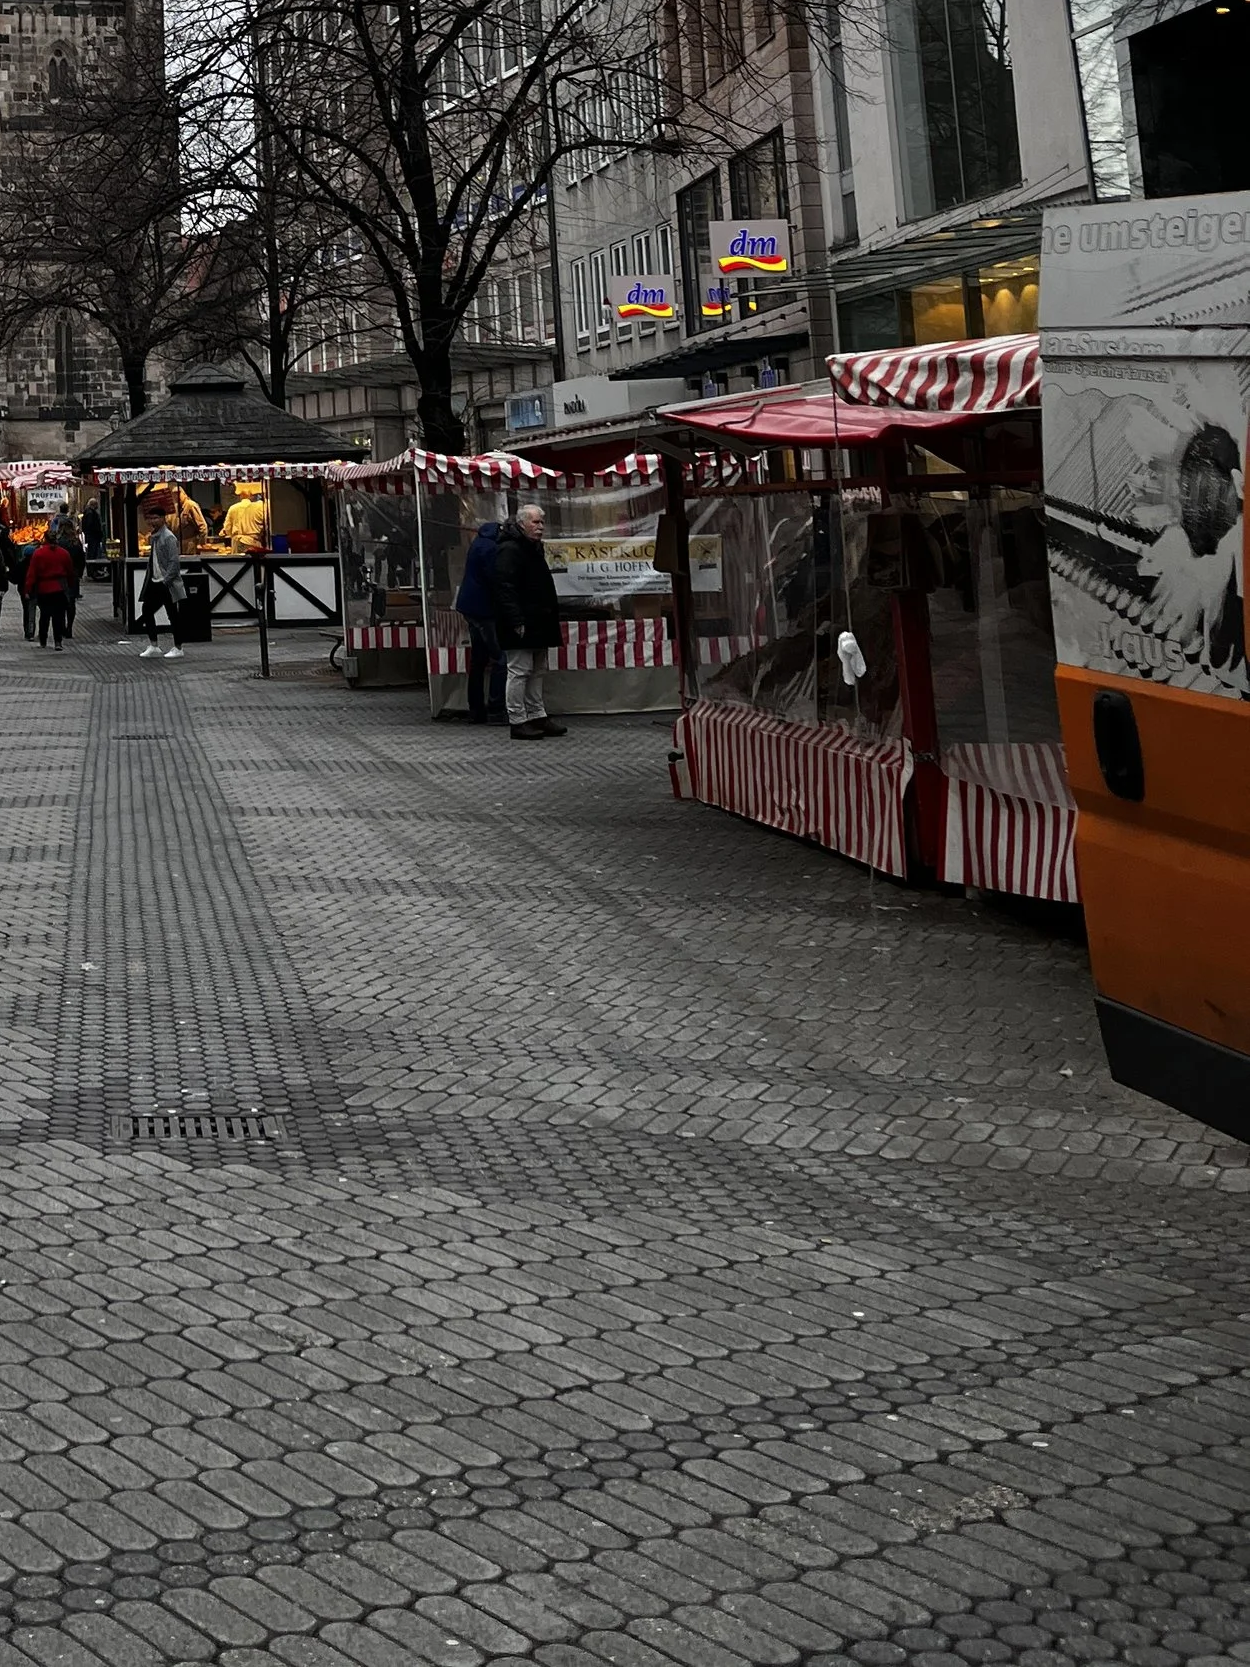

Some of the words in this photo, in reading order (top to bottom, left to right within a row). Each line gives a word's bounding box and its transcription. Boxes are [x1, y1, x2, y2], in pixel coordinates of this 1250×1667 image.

[729, 230, 777, 256] dm
[627, 283, 665, 304] dm
[31, 491, 63, 499] TRÜFFEL
